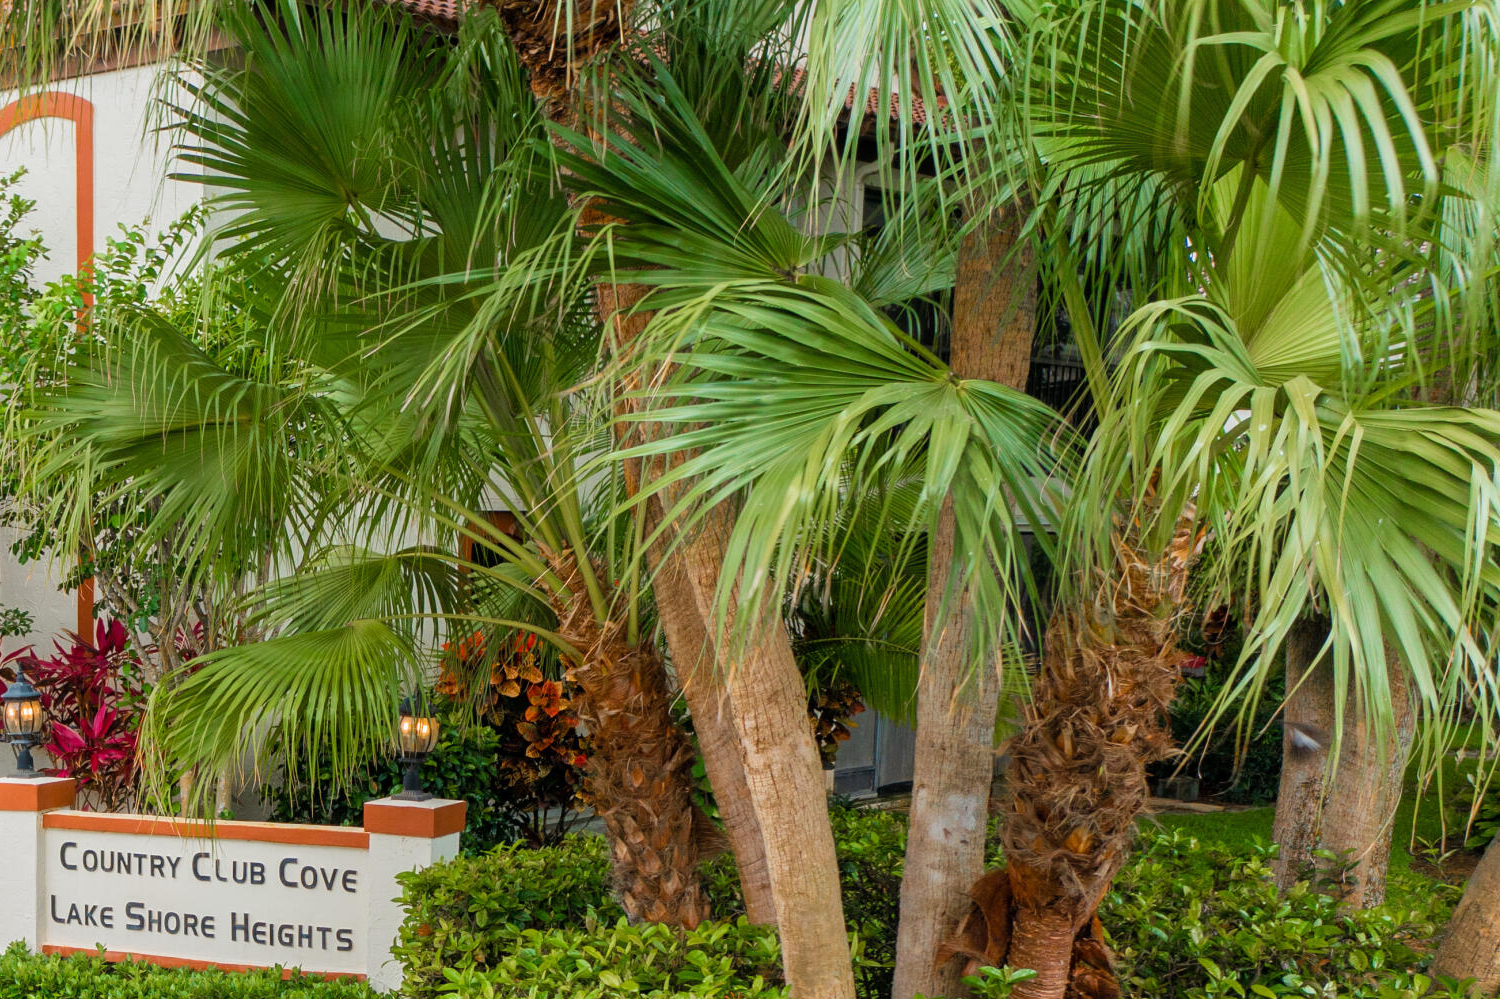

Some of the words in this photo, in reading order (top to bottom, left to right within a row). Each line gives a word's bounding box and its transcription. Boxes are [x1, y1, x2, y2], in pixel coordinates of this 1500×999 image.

[59, 841, 182, 879] COUNTRY
[192, 852, 266, 886] CLUB
[279, 857, 358, 893] COVE
[50, 894, 114, 929] LAKE
[125, 901, 216, 939] SHORE
[231, 911, 354, 952] HEIGHTS
